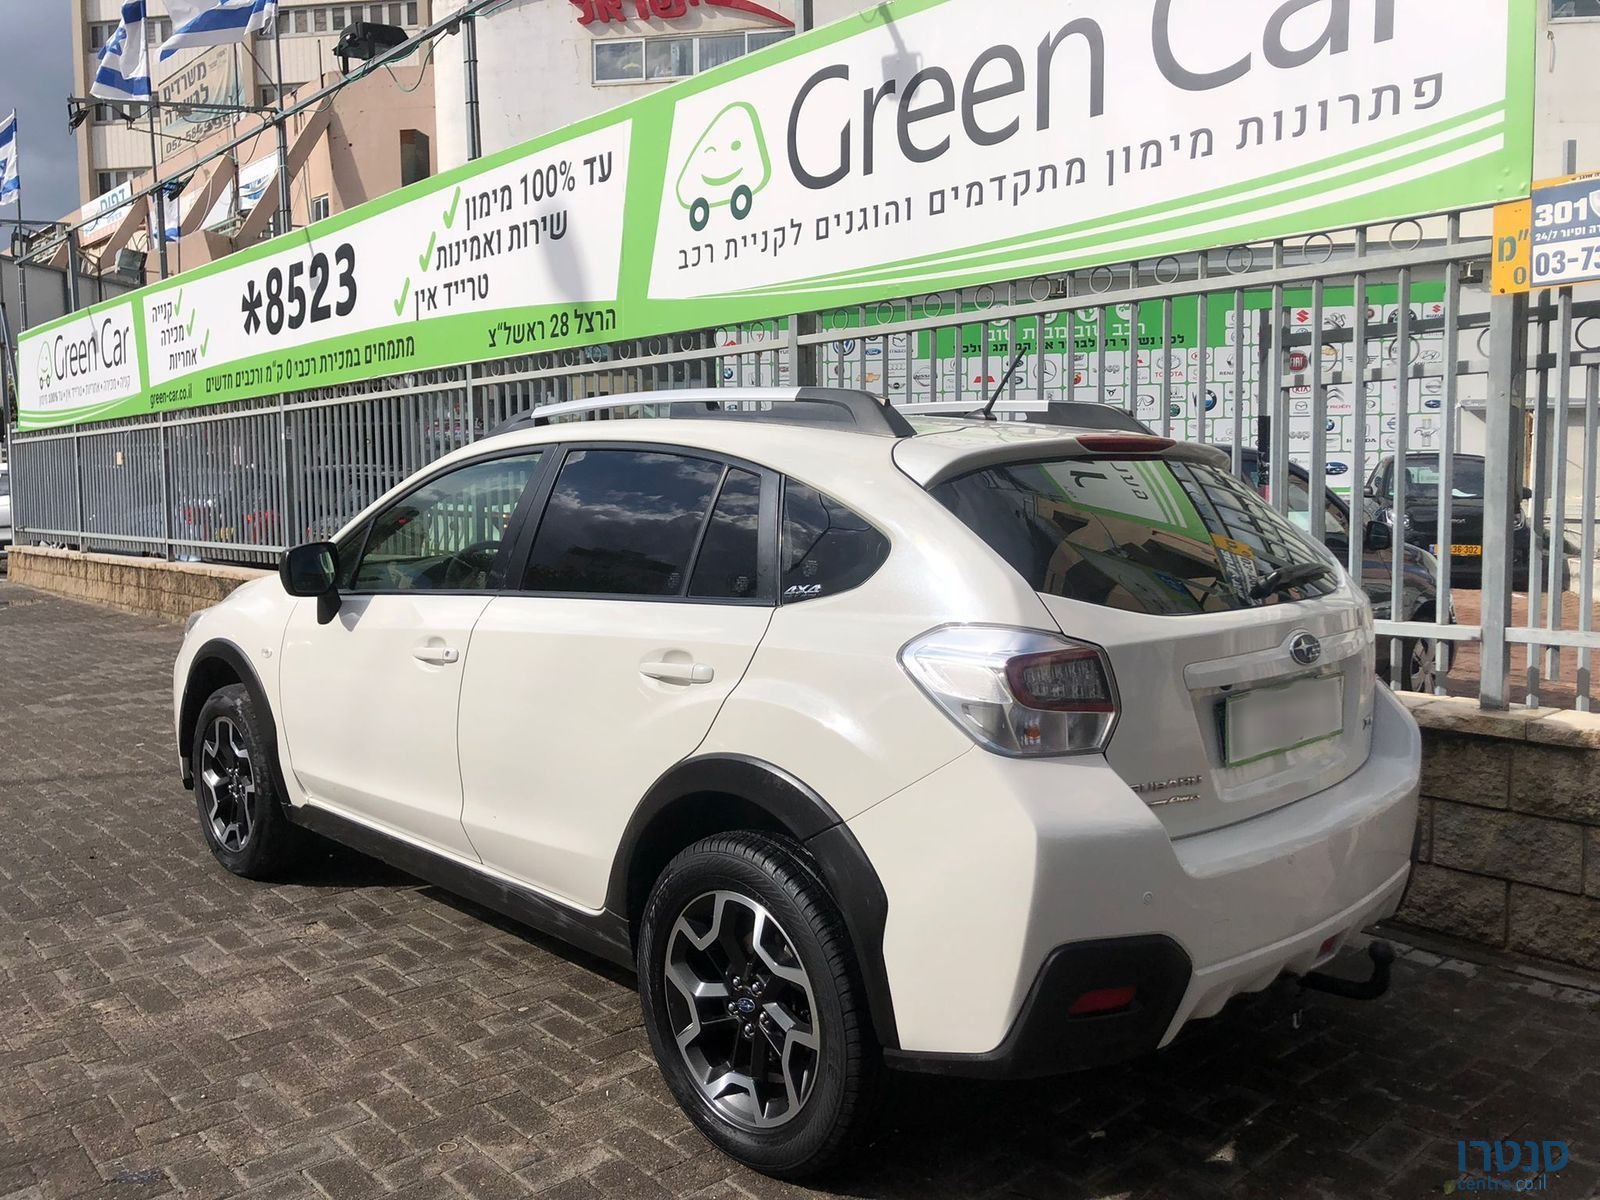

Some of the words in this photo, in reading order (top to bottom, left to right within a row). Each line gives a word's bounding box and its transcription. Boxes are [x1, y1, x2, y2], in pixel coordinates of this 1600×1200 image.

[163, 62, 207, 103] משרדים
[786, 17, 1105, 190] Green
[1236, 72, 1444, 151] פתרונות
[583, 151, 613, 186] עד
[1107, 128, 1213, 186] מימון
[520, 160, 576, 205] 100%
[929, 156, 1087, 215] מתקדמים
[465, 184, 513, 231] מימון
[815, 196, 912, 241] והוגנים
[1534, 197, 1588, 227] 301
[508, 210, 568, 252] שירות
[724, 218, 803, 257] לקניית
[436, 229, 501, 271] ואמינות
[678, 243, 714, 270] רכב
[414, 285, 438, 321] אין
[443, 273, 489, 306] טרייד
[161, 325, 184, 346] מכירה
[550, 312, 569, 338] 28
[574, 308, 616, 334] הרצל
[54, 335, 97, 380] Green
[101, 318, 130, 368] Car
[169, 348, 197, 370] אחריות
[319, 348, 361, 373] במכירת
[364, 336, 415, 359] מתמחים
[206, 376, 232, 392] חדשים
[235, 367, 263, 387] ורכבים
[295, 357, 316, 378] רכבי
